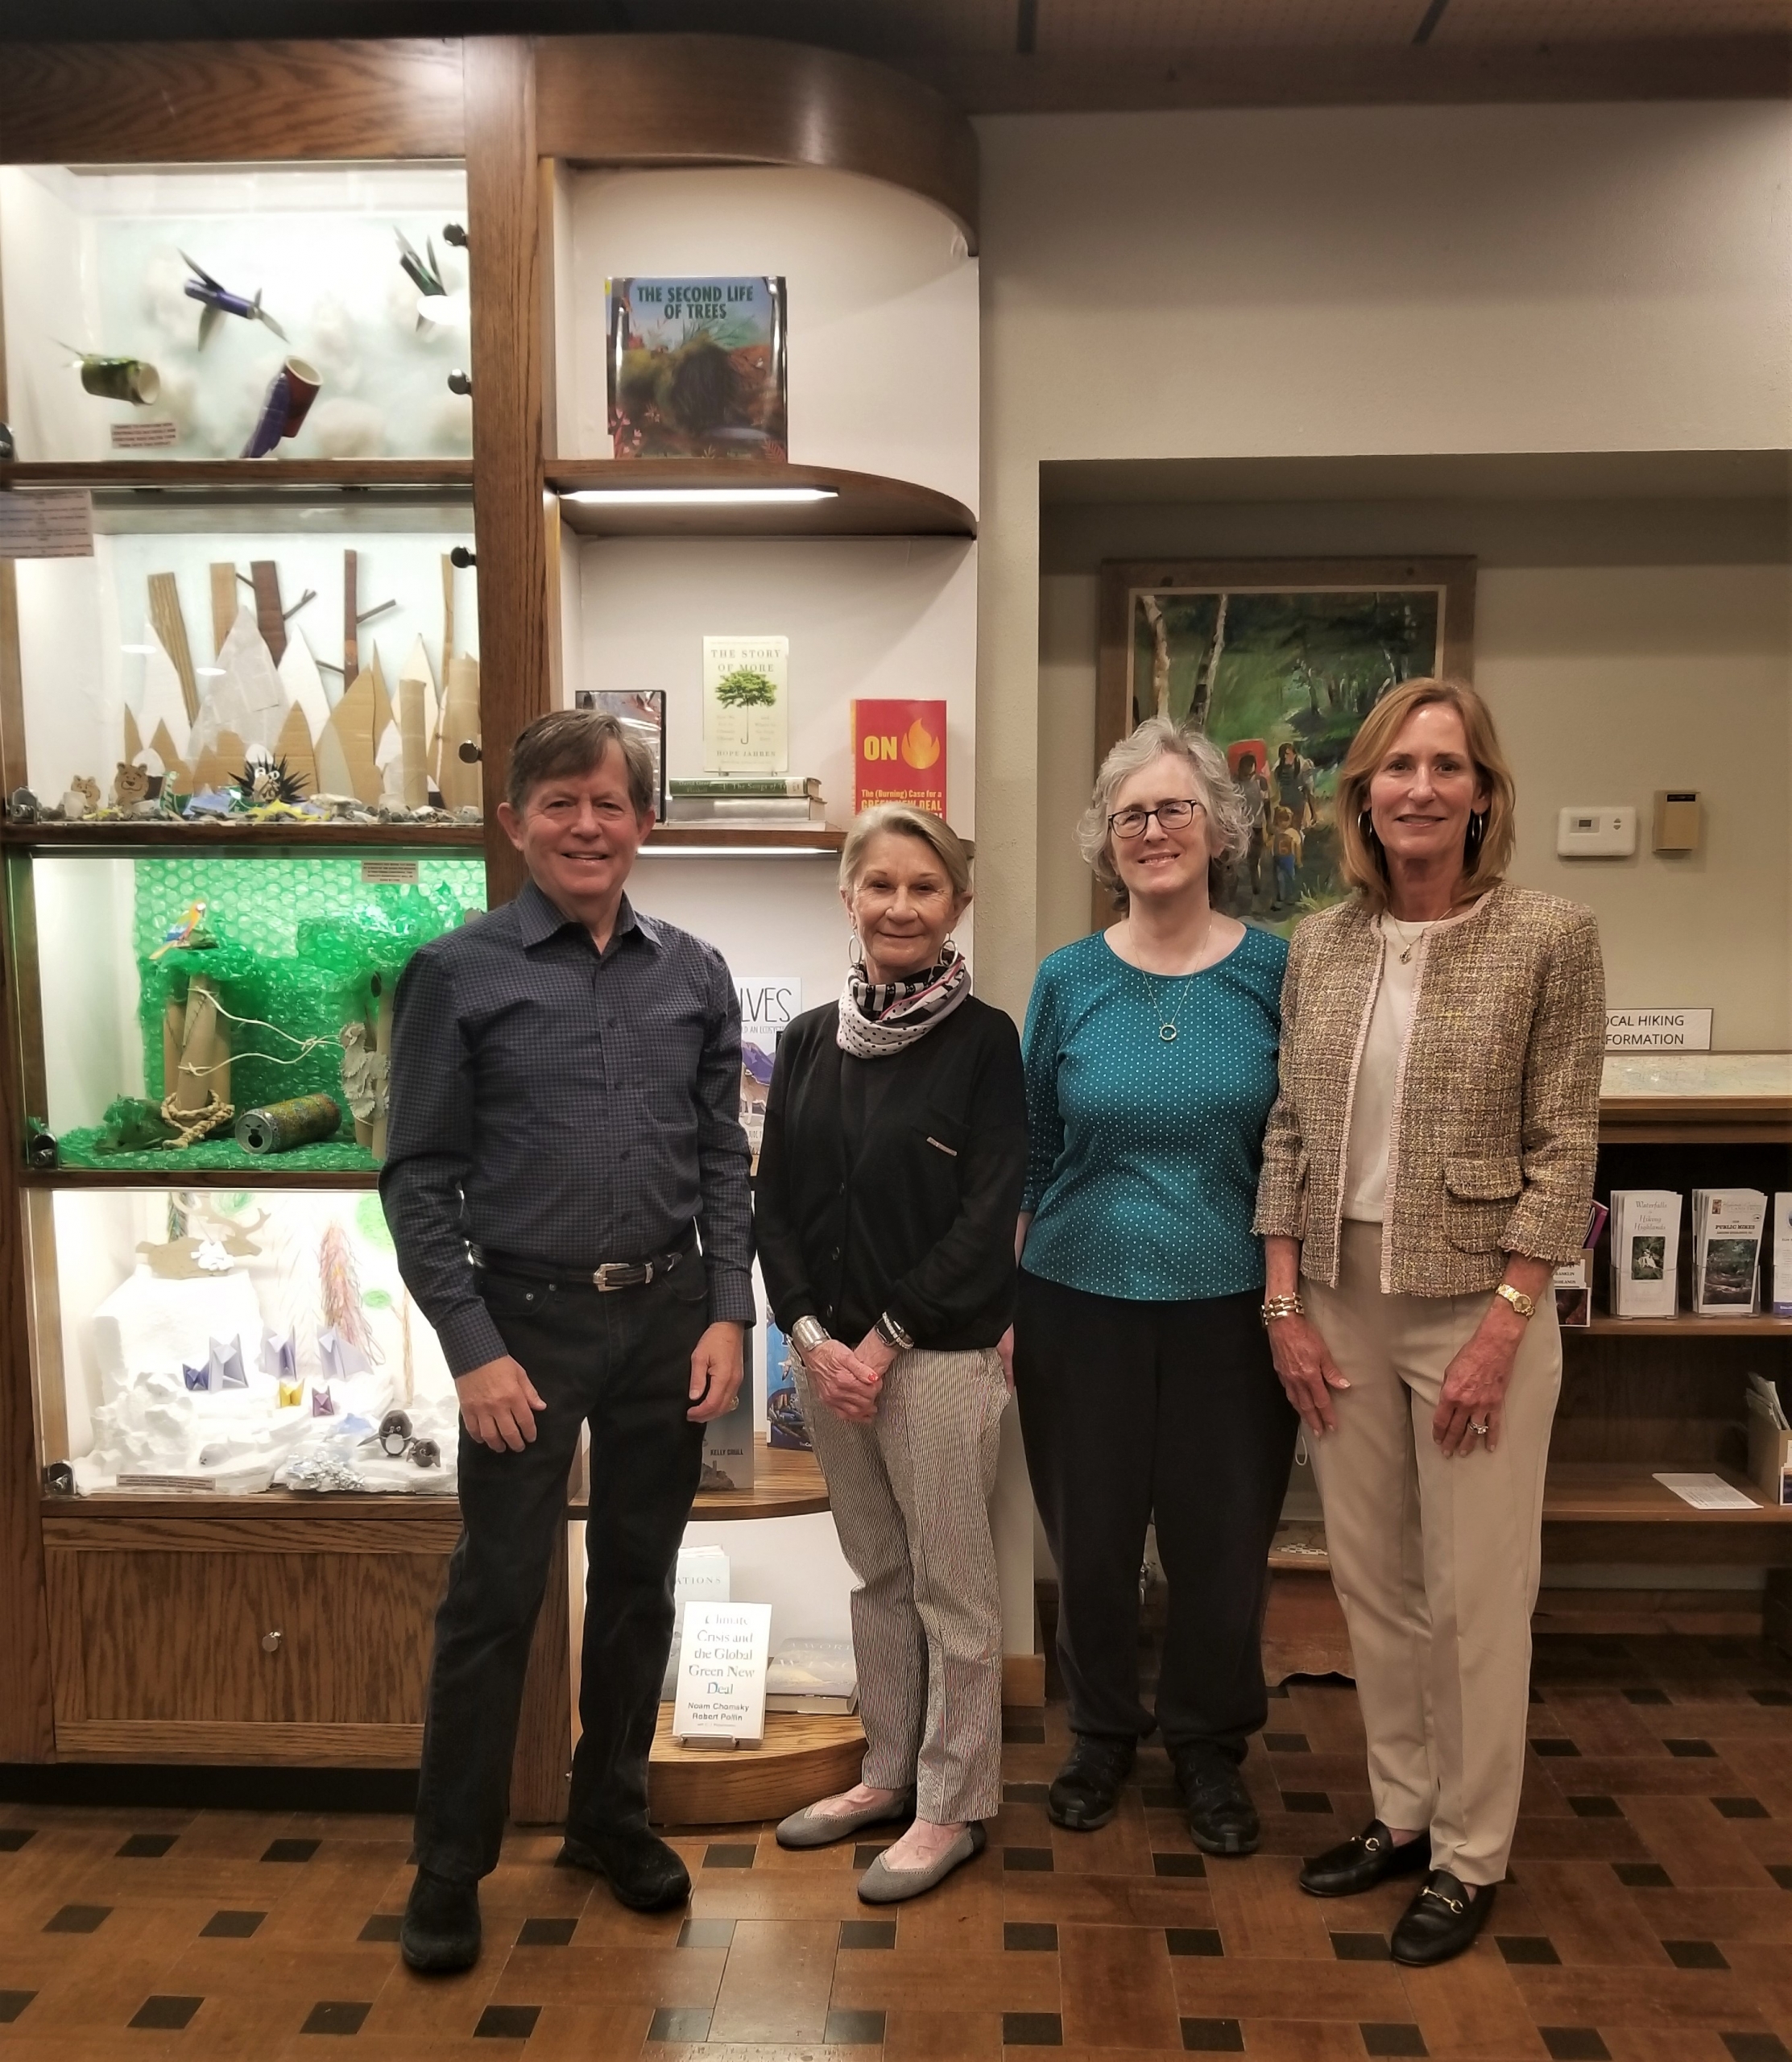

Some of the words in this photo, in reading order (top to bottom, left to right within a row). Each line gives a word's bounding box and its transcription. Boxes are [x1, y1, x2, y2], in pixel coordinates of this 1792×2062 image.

[637, 286, 662, 302] THE
[668, 285, 722, 303] SECOND
[727, 285, 753, 302] LIFE
[664, 304, 681, 319] OF
[687, 304, 726, 319] TREES
[711, 649, 735, 658] THE
[741, 649, 780, 658] STORY
[718, 664, 734, 672] OF
[740, 664, 774, 672] MORE
[863, 735, 898, 761] ON
[861, 789, 874, 797] The
[875, 789, 908, 799] (Burning)
[926, 789, 937, 797] for
[919, 801, 942, 810] DEAL
[740, 988, 792, 1022] LVES
[1605, 1016, 1634, 1026] CAL
[1638, 1016, 1684, 1026] HIKING
[1605, 1034, 1684, 1045] FORMATION
[1635, 1200, 1667, 1210] Waterfalls
[1639, 1215, 1662, 1224] Hiking
[1633, 1222, 1666, 1232] Highlands
[710, 1448, 726, 1456] KELLY
[677, 1576, 721, 1585] ATIONS
[697, 1629, 730, 1642] Crisis
[732, 1633, 753, 1643] and
[694, 1648, 712, 1659] the
[714, 1648, 752, 1660] Global
[689, 1664, 723, 1677] Green
[726, 1665, 755, 1678] New
[706, 1681, 734, 1695] Deal
[688, 1702, 710, 1710] Noam
[713, 1703, 749, 1712] Chomsky
[693, 1712, 718, 1720] Robert
[720, 1713, 743, 1721] Pollin
